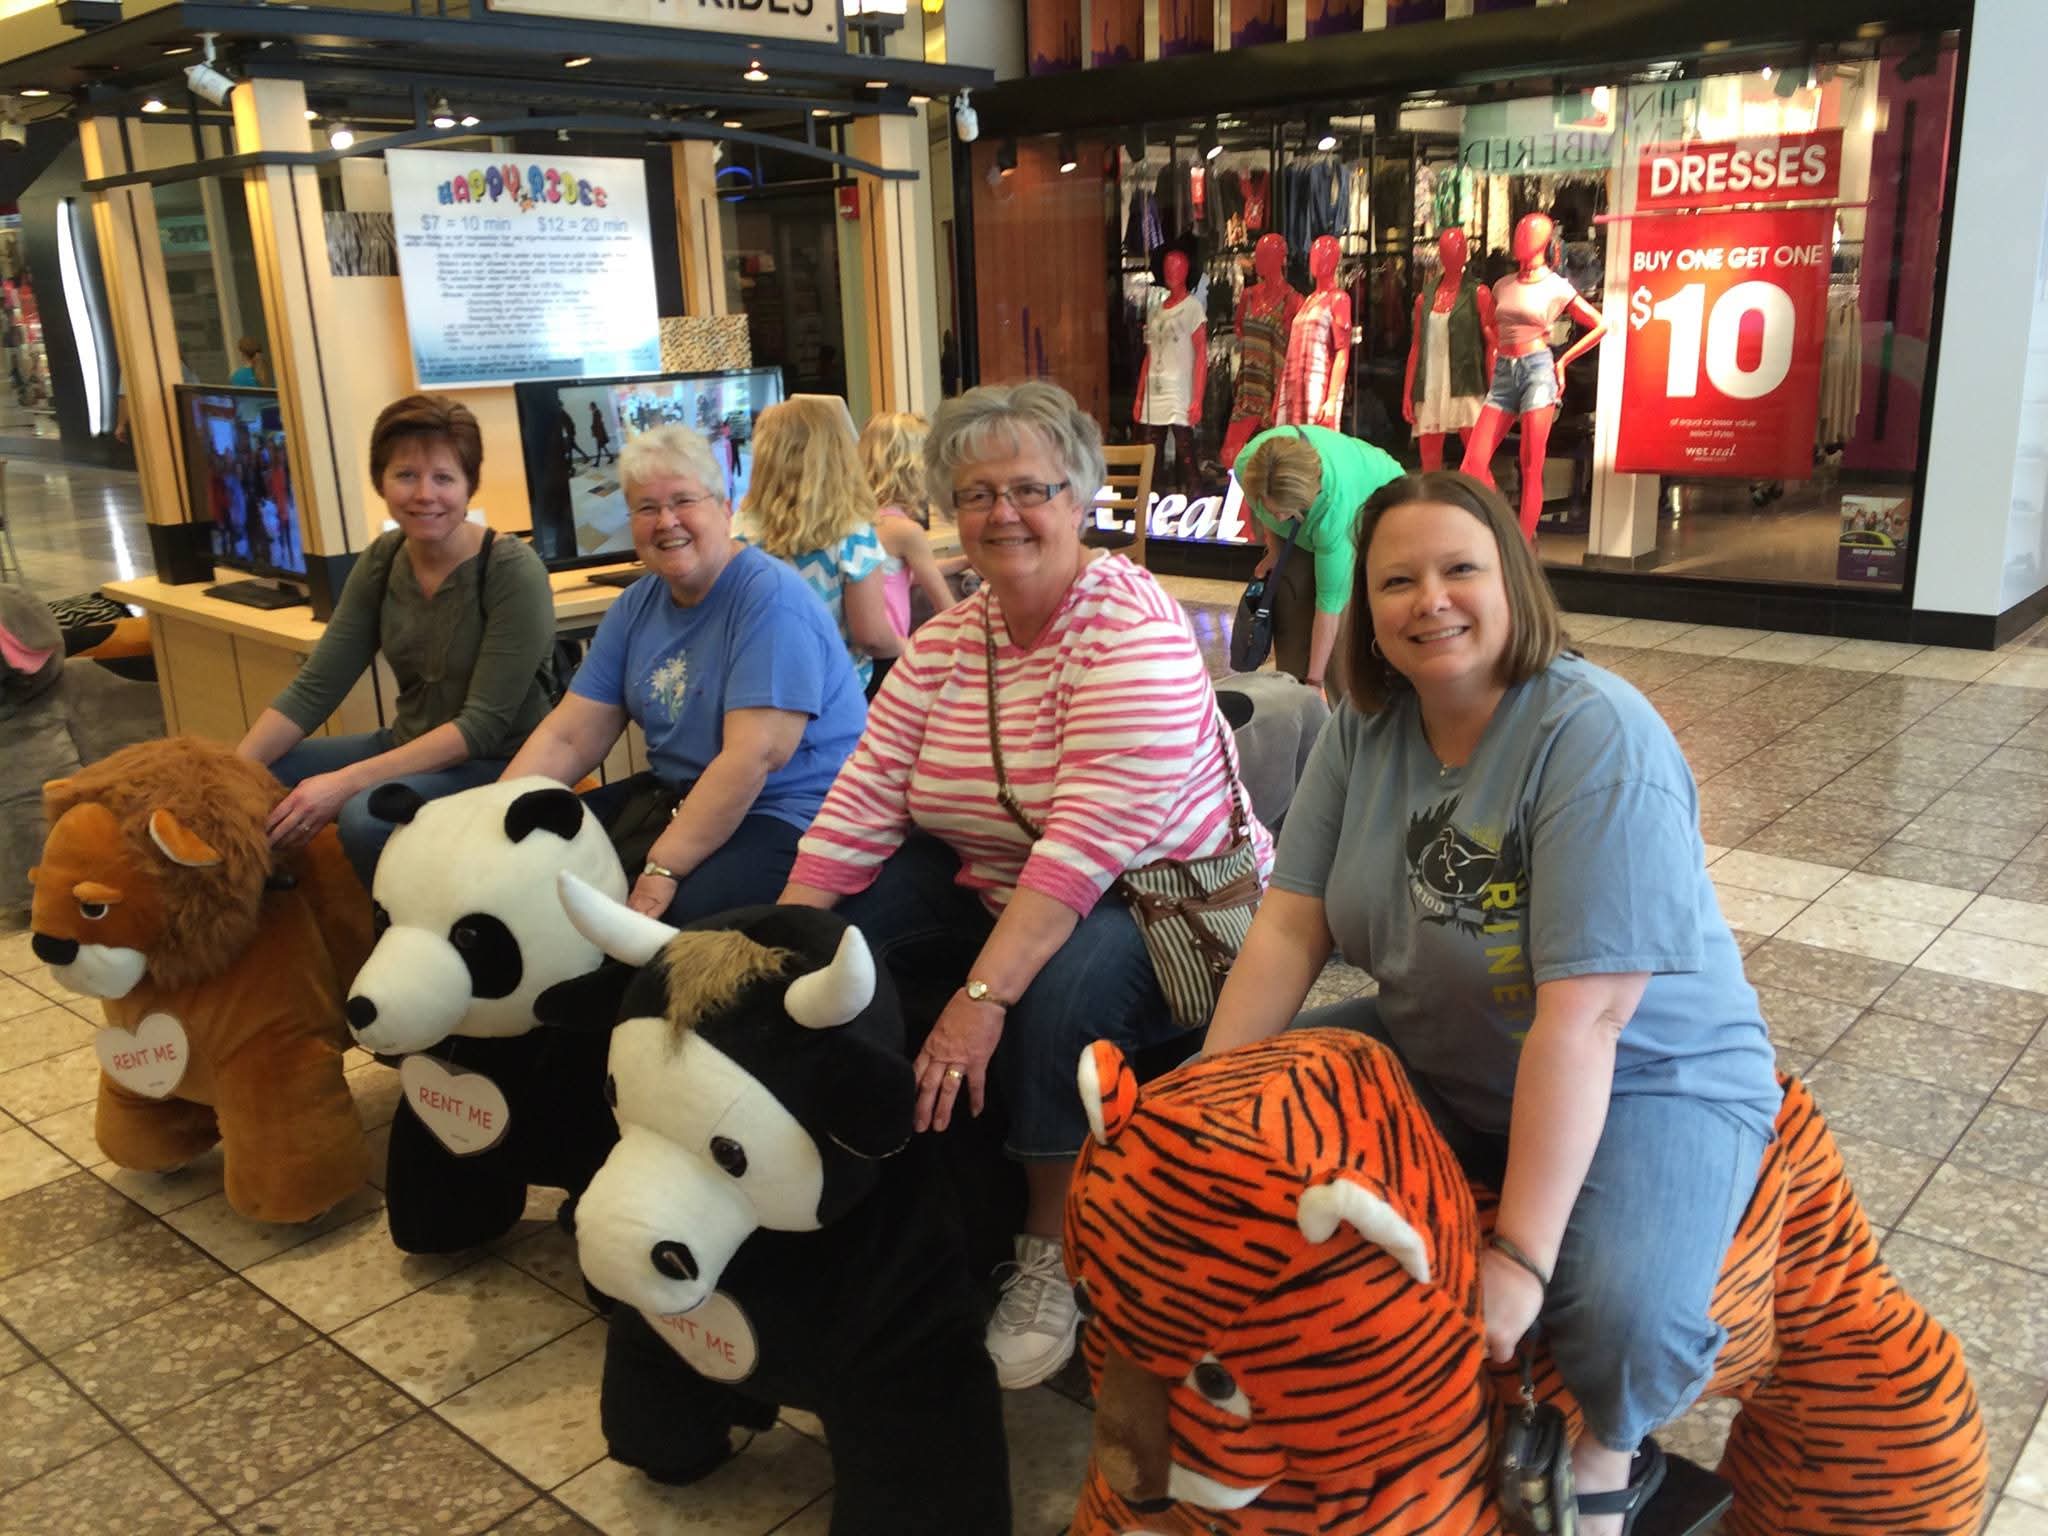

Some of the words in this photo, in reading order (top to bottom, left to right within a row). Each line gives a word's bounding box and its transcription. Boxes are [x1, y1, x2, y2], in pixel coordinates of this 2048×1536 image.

[437, 164, 521, 205] HAPPY
[1650, 145, 1826, 197] DRESSES
[420, 214, 440, 231] $7
[461, 216, 480, 231] 10
[484, 216, 511, 231] min
[537, 216, 563, 232] $12
[582, 217, 599, 231] 20
[604, 217, 629, 231] min
[1633, 250, 1673, 272] BUY
[1676, 247, 1725, 271] ONE
[1728, 246, 1770, 270] GET
[1773, 244, 1825, 268] ONE
[1630, 281, 1796, 399] $10
[1685, 447, 1709, 456] wet
[1710, 444, 1736, 456] seal
[112, 1049, 149, 1070] RENT
[153, 1042, 177, 1063] ME
[419, 1087, 464, 1117] RENT
[468, 1105, 493, 1130] ME
[658, 1315, 699, 1341] NT
[704, 1328, 737, 1365] ME
